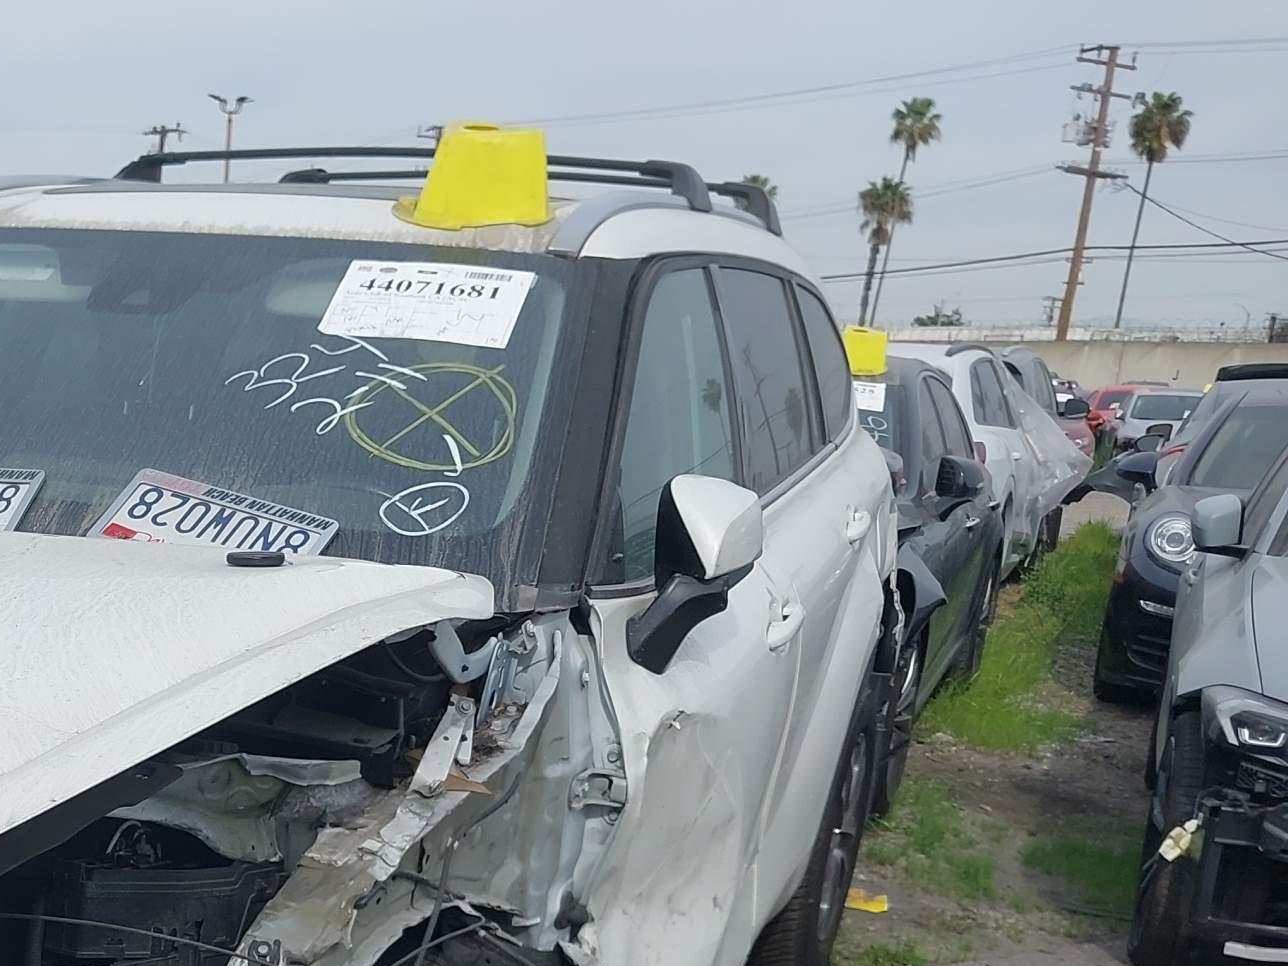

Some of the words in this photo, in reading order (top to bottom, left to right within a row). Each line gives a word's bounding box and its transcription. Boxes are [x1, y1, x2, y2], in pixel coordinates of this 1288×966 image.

[359, 278, 501, 300] 44071681
[201, 488, 249, 508] BEACH
[127, 487, 310, 553] 8NUW028
[245, 500, 335, 530] MANHATTAN
